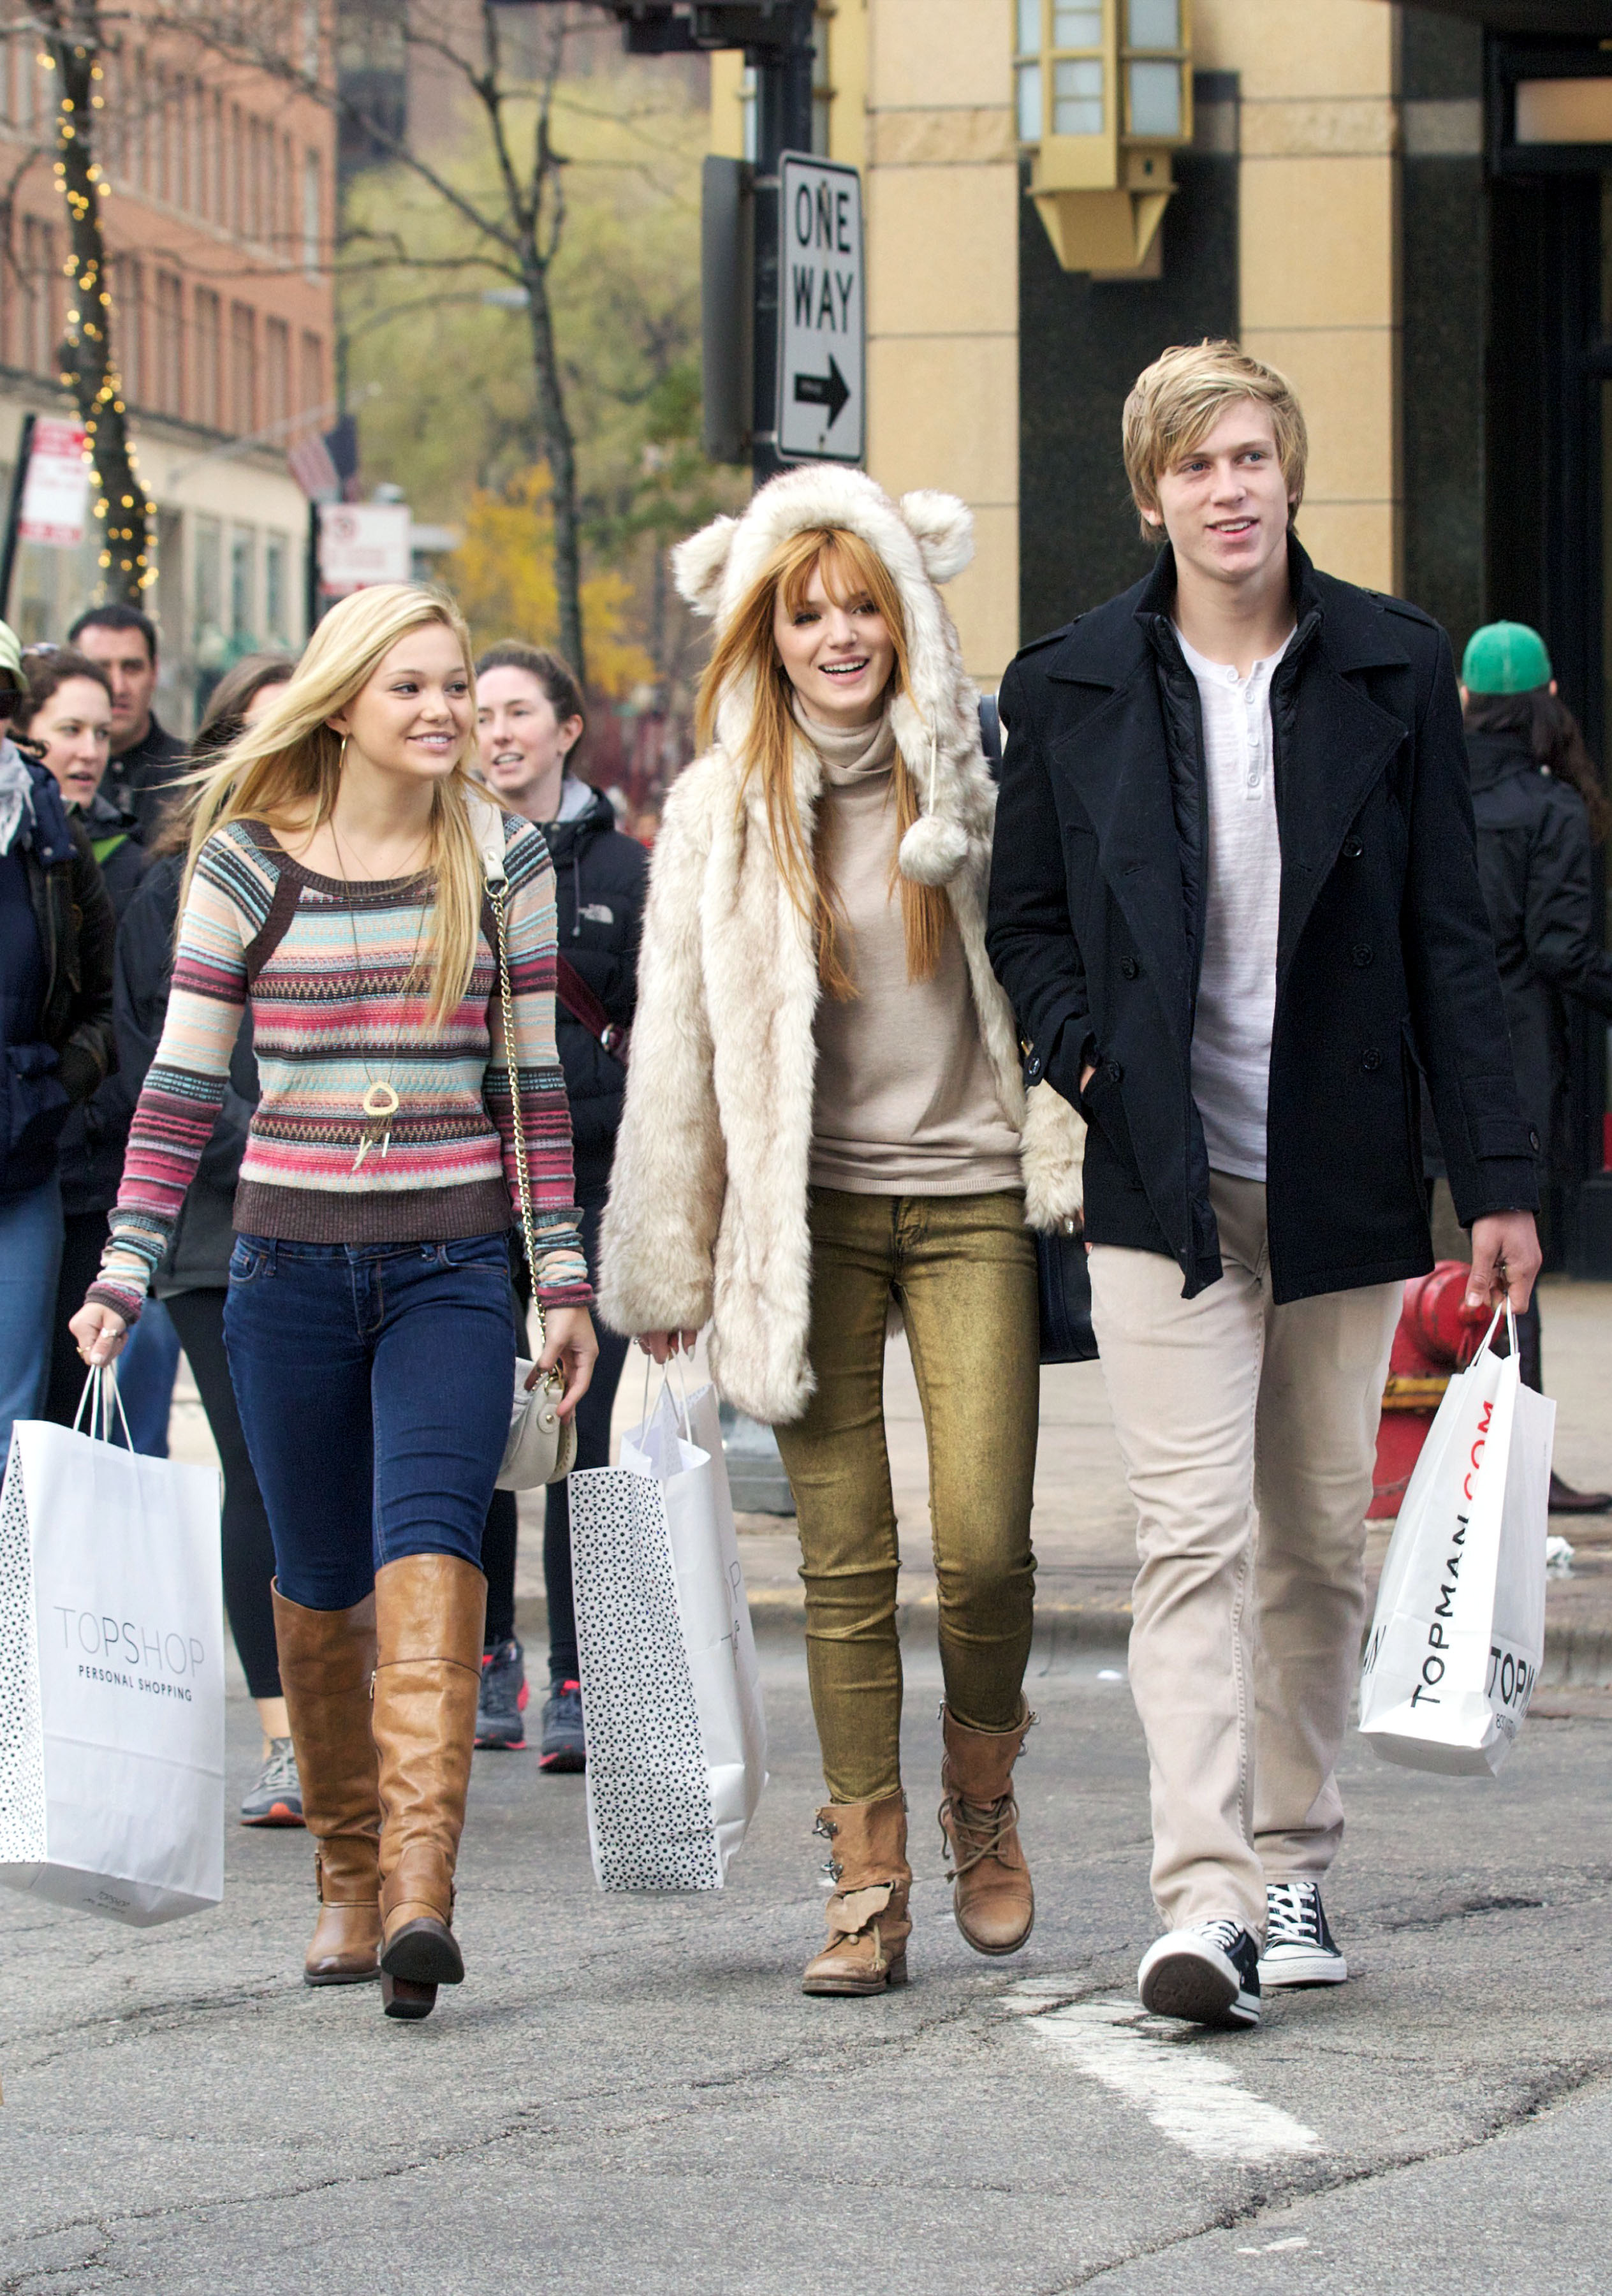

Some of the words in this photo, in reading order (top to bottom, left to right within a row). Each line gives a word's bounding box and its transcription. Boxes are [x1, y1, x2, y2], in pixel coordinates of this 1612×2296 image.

[795, 182, 852, 253] ONE
[793, 263, 853, 334] WAY
[54, 1606, 205, 1677] TOPSHOP
[78, 1665, 134, 1688] PERSONAL
[138, 1677, 192, 1702] SHOPPING
